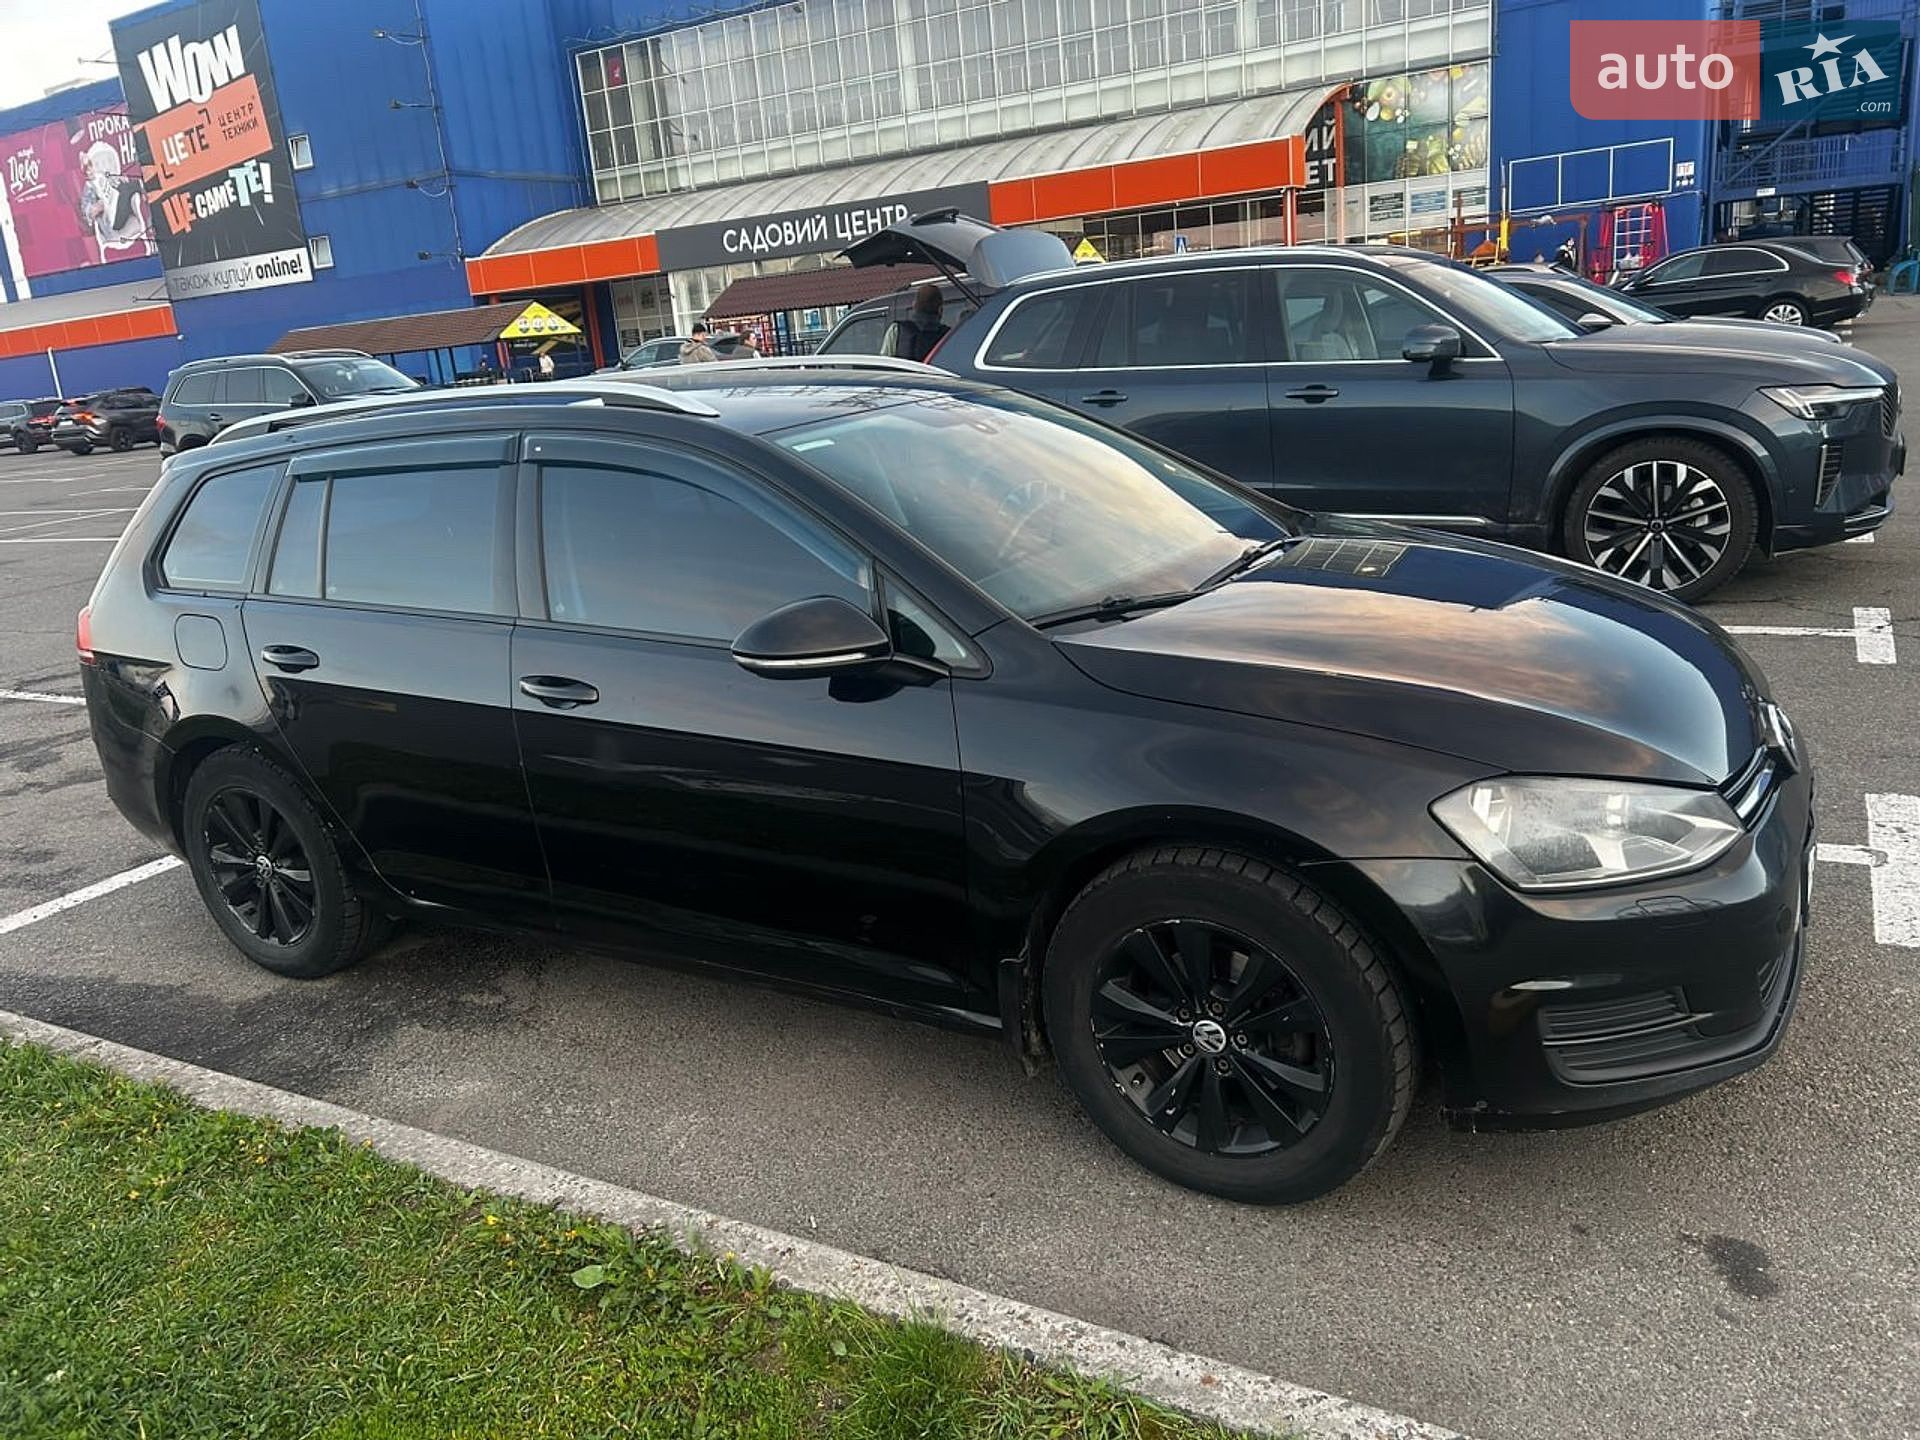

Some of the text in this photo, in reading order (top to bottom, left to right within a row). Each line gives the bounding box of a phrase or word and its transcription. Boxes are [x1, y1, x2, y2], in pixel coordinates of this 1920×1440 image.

[217, 102, 254, 128] ЦЕНТР
[161, 124, 210, 166] ЦЕТЕ
[722, 213, 828, 253] САДОВИЙ
[174, 253, 303, 292] також купуй online!
